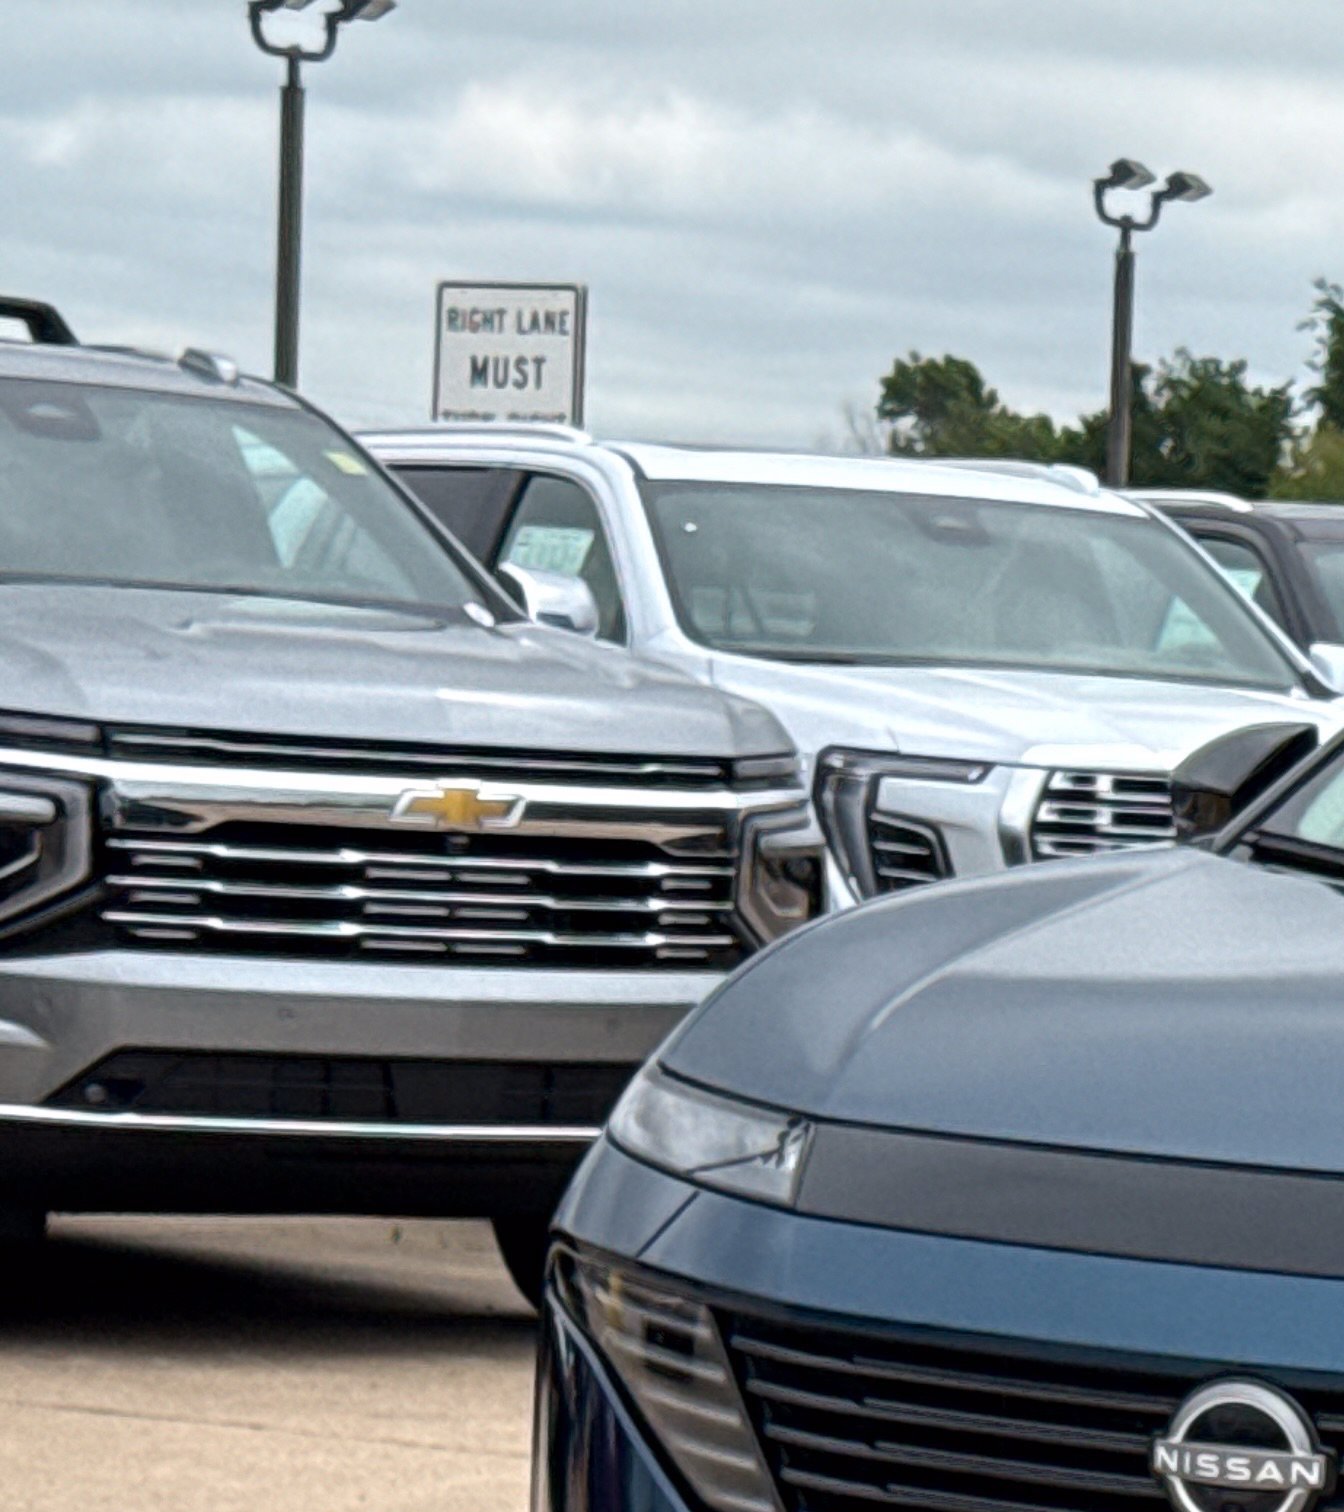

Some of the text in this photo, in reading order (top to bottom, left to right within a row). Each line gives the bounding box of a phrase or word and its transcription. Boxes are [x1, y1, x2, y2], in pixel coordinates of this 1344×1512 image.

[446, 307, 570, 336] RIGHT LANE
[470, 354, 546, 390] MUST
[1154, 1445, 1322, 1486] NISSAN
